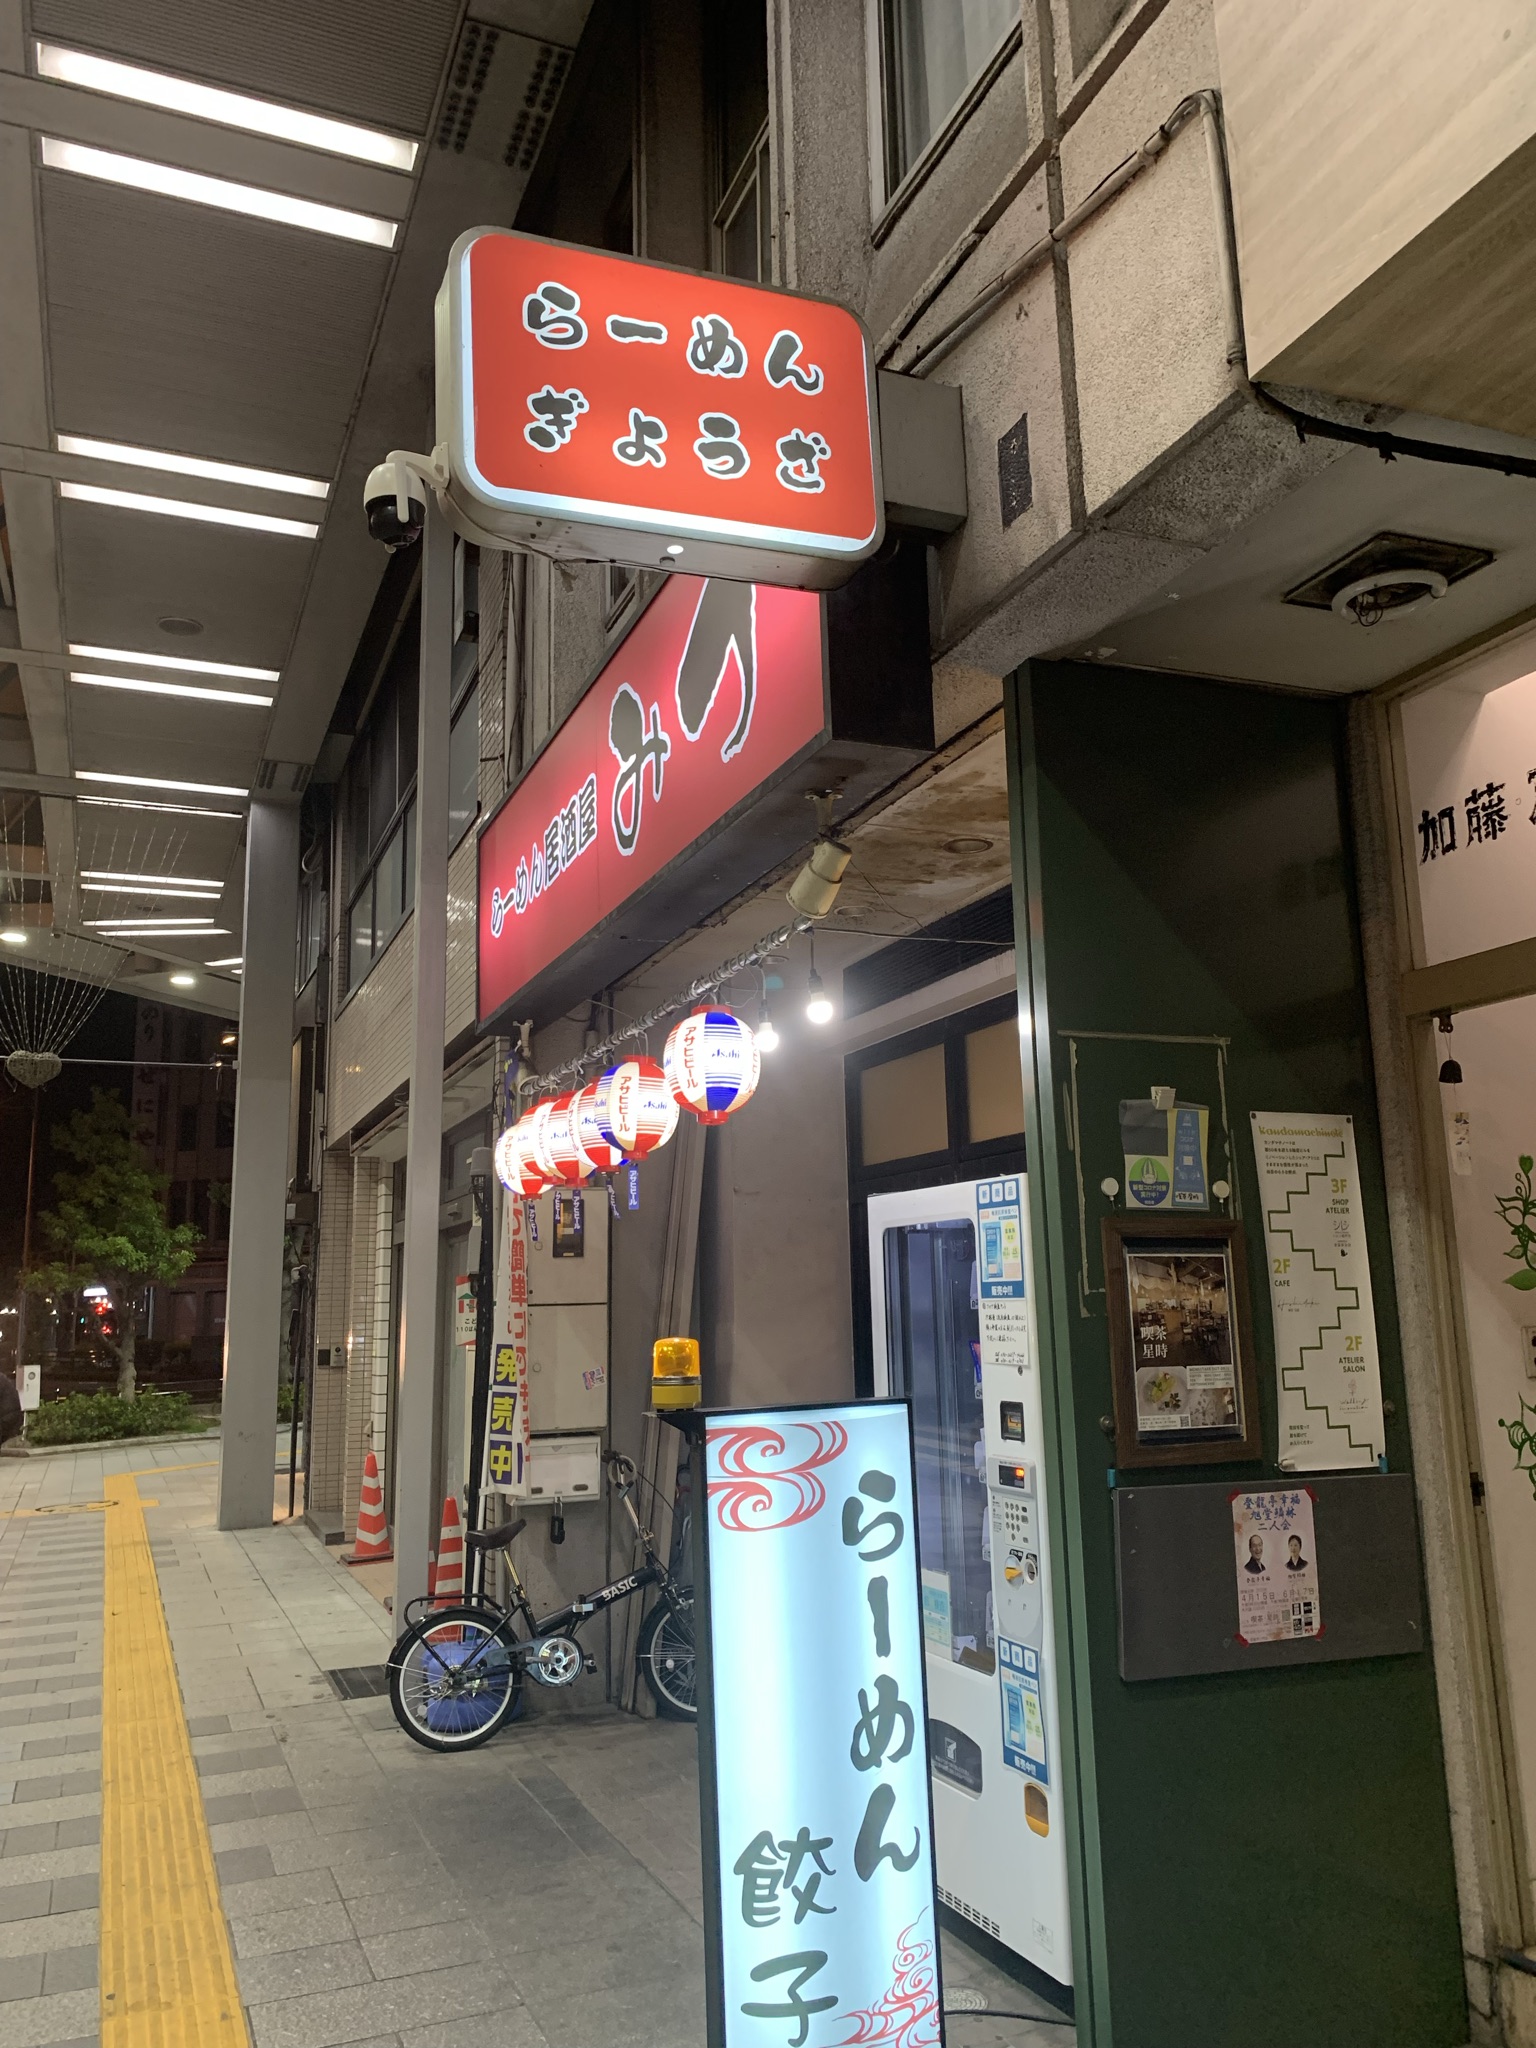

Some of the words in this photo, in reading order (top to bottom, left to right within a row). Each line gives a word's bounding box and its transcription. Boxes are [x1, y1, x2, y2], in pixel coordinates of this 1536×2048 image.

[523, 282, 824, 396] らーめん
[524, 384, 831, 494] ぎょうざ
[1418, 767, 1536, 866] 加藤
[491, 774, 598, 938] らーめん居酒屋
[684, 1026, 699, 1089] アサヒビール
[711, 1048, 740, 1059] Asahi
[619, 1076, 632, 1132] アサヒビール
[643, 1100, 668, 1110] Asahi
[629, 1170, 638, 1206] アサヒビール
[981, 1183, 1014, 1200] 新商品
[1331, 1179, 1347, 1194] 3F
[1332, 1198, 1349, 1206] SHOP
[573, 1196, 581, 1230] アサヒビール
[1273, 1259, 1291, 1274] 2F
[1274, 1279, 1291, 1287] CAFE
[1140, 1325, 1167, 1341] 喫茶
[1143, 1344, 1168, 1359] 星時
[1345, 1336, 1363, 1351] 2F
[1339, 1356, 1364, 1364] ATELIER
[1343, 1365, 1366, 1373] SALON
[490, 1348, 517, 1480] 発売中
[1243, 1493, 1301, 1510] 登龍亭幸福
[1257, 1518, 1292, 1531] 二人会
[601, 1576, 638, 1601] BASIC
[1241, 1592, 1275, 1602] 4月15日
[842, 1470, 921, 1882] らーめん
[734, 1826, 839, 2047] 餃子
